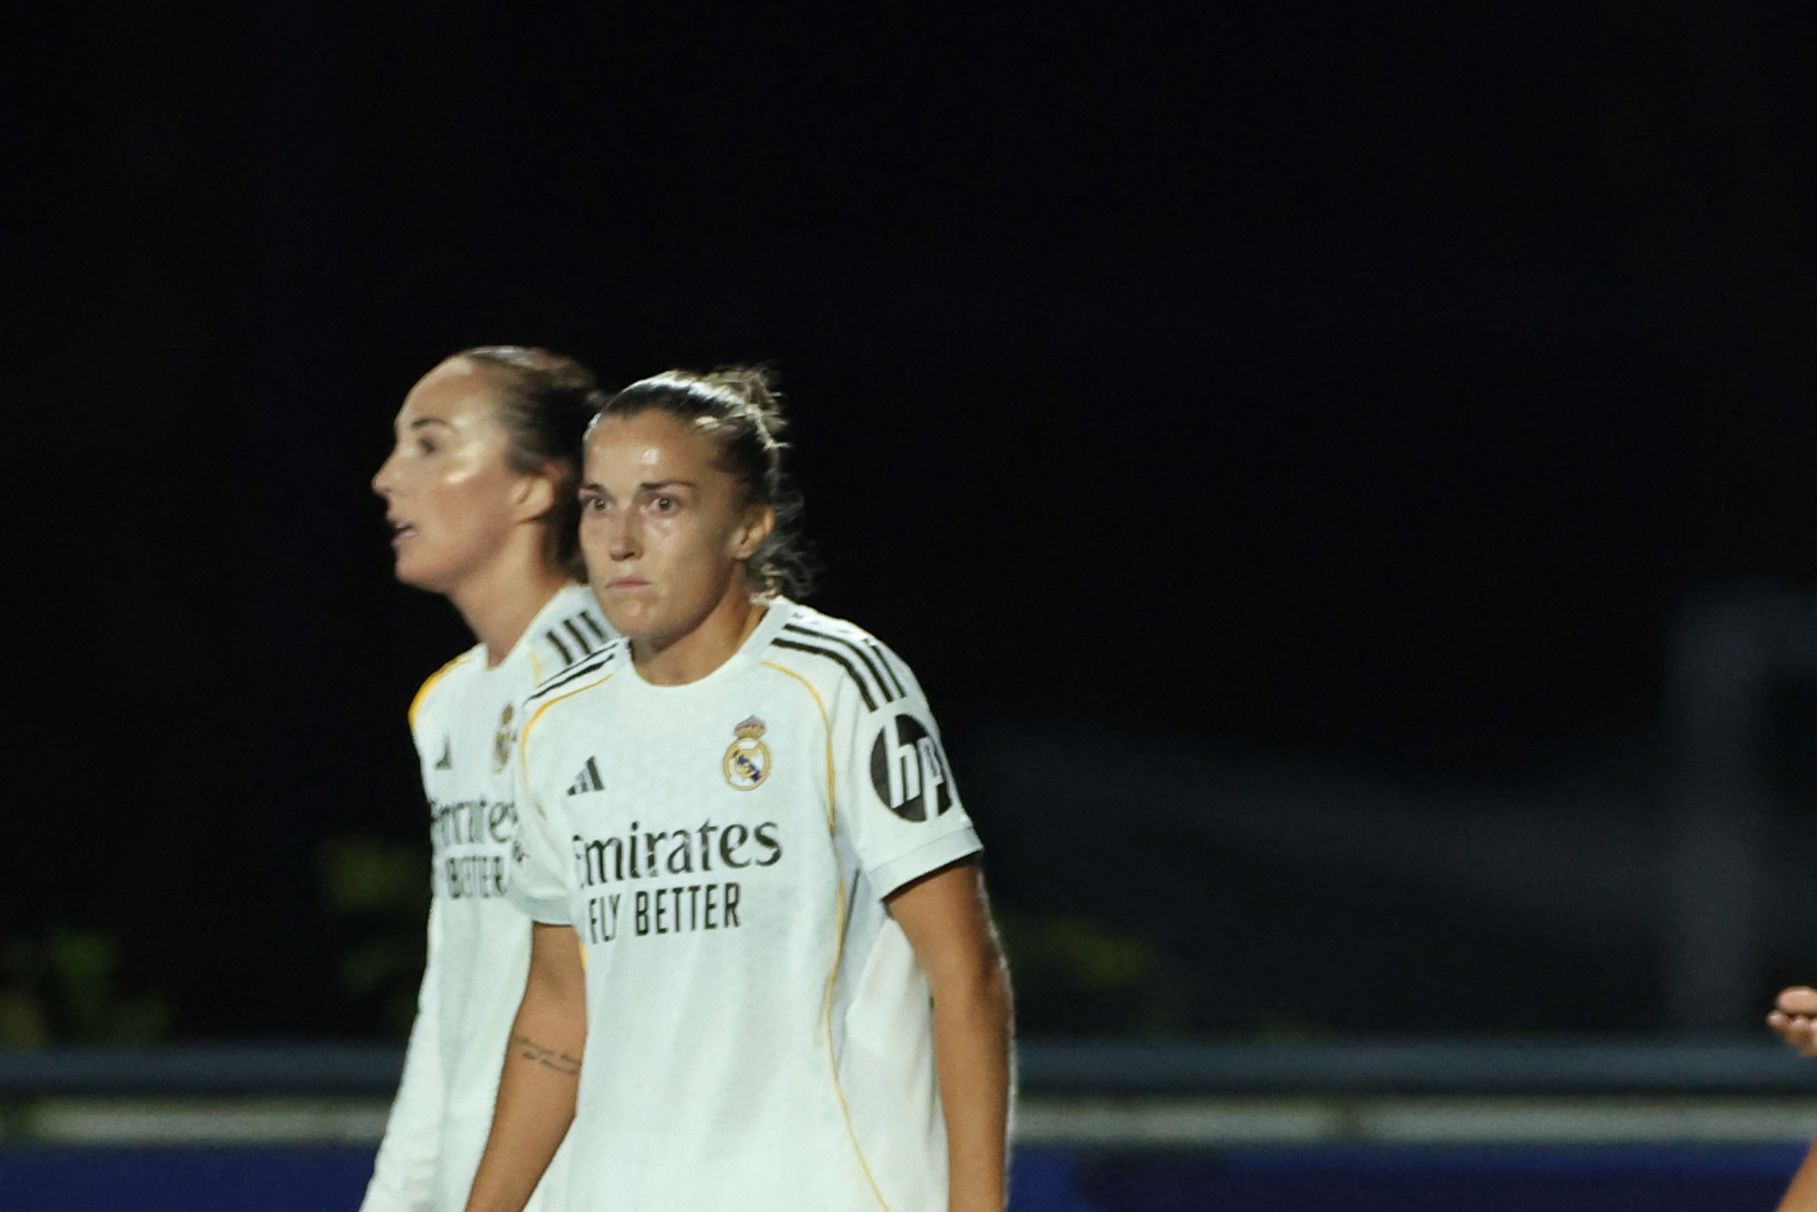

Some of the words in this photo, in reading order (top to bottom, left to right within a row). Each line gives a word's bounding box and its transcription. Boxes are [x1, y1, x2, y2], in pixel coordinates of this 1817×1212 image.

[876, 713, 951, 823] hp
[588, 893, 622, 945] FLY
[635, 881, 741, 936] BETTER
